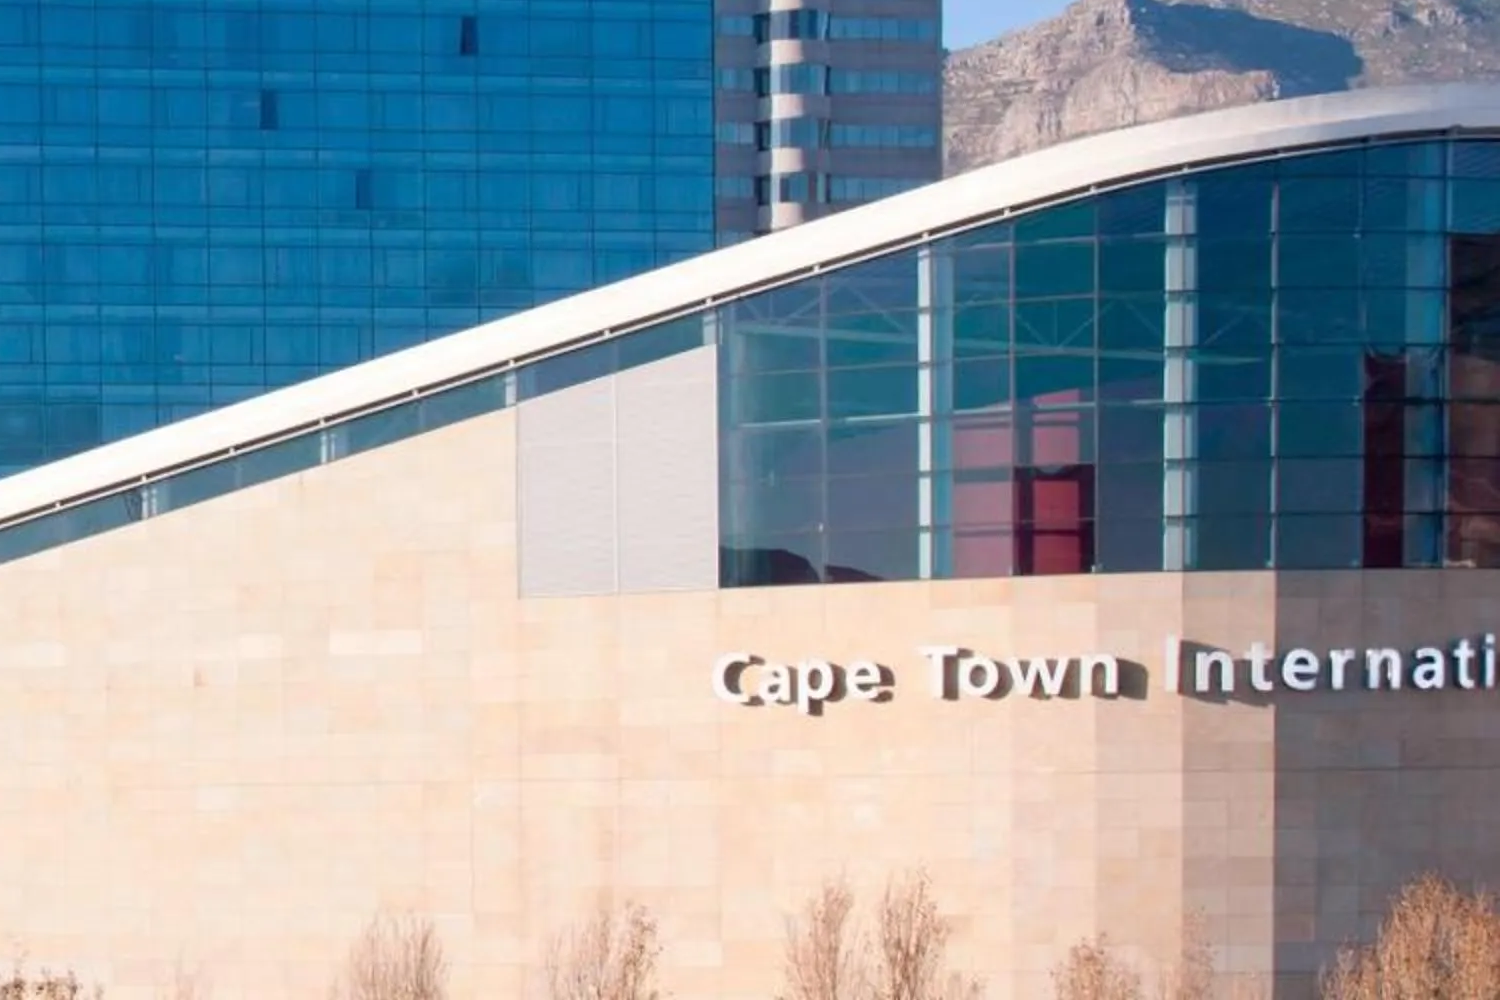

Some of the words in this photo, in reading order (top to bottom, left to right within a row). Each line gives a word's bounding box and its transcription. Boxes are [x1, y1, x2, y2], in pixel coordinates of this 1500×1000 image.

[712, 652, 882, 714] Cape
[918, 644, 1119, 699] Town
[1163, 632, 1496, 693] Internati
